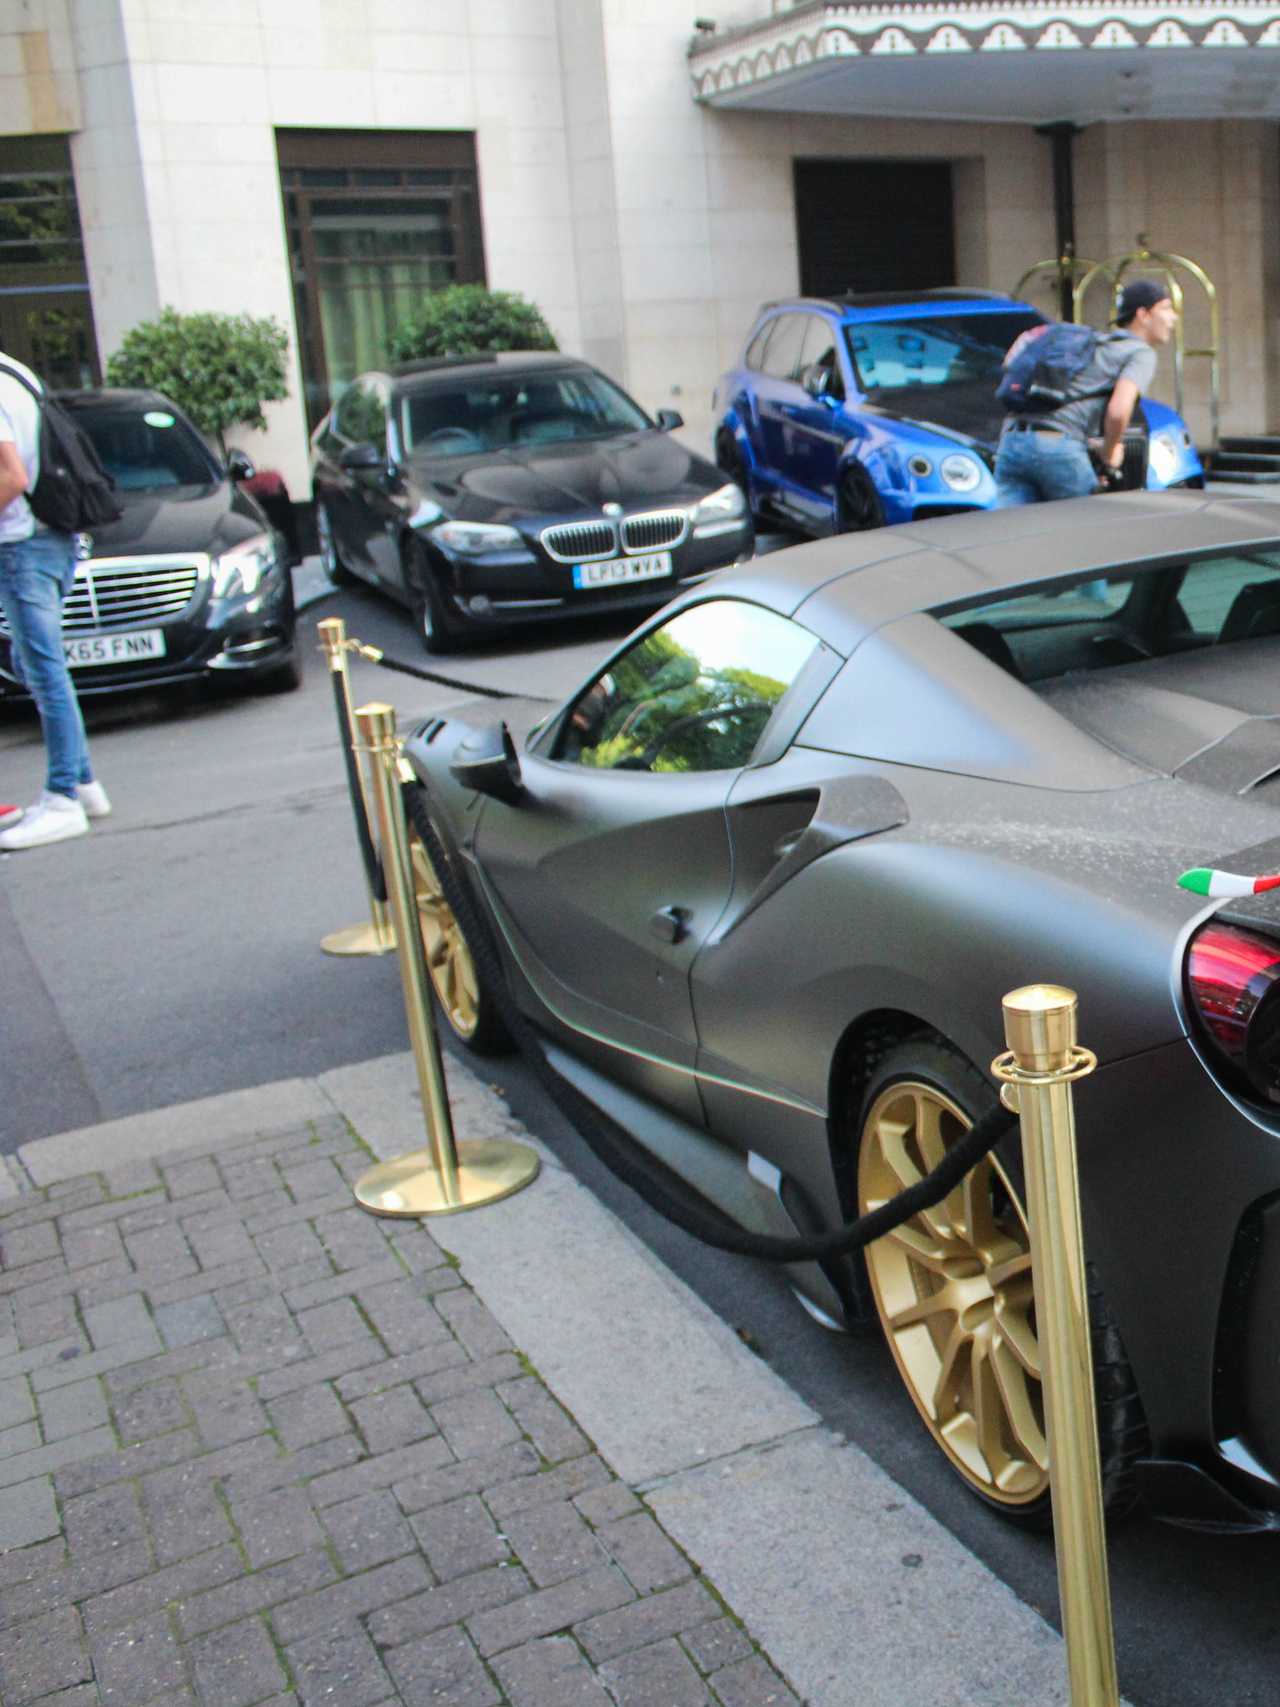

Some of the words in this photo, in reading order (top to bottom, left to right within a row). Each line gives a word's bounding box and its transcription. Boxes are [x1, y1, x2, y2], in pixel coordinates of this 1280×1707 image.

[631, 557, 663, 576] WVA
[62, 640, 105, 661] K65
[111, 634, 154, 657] FNN
